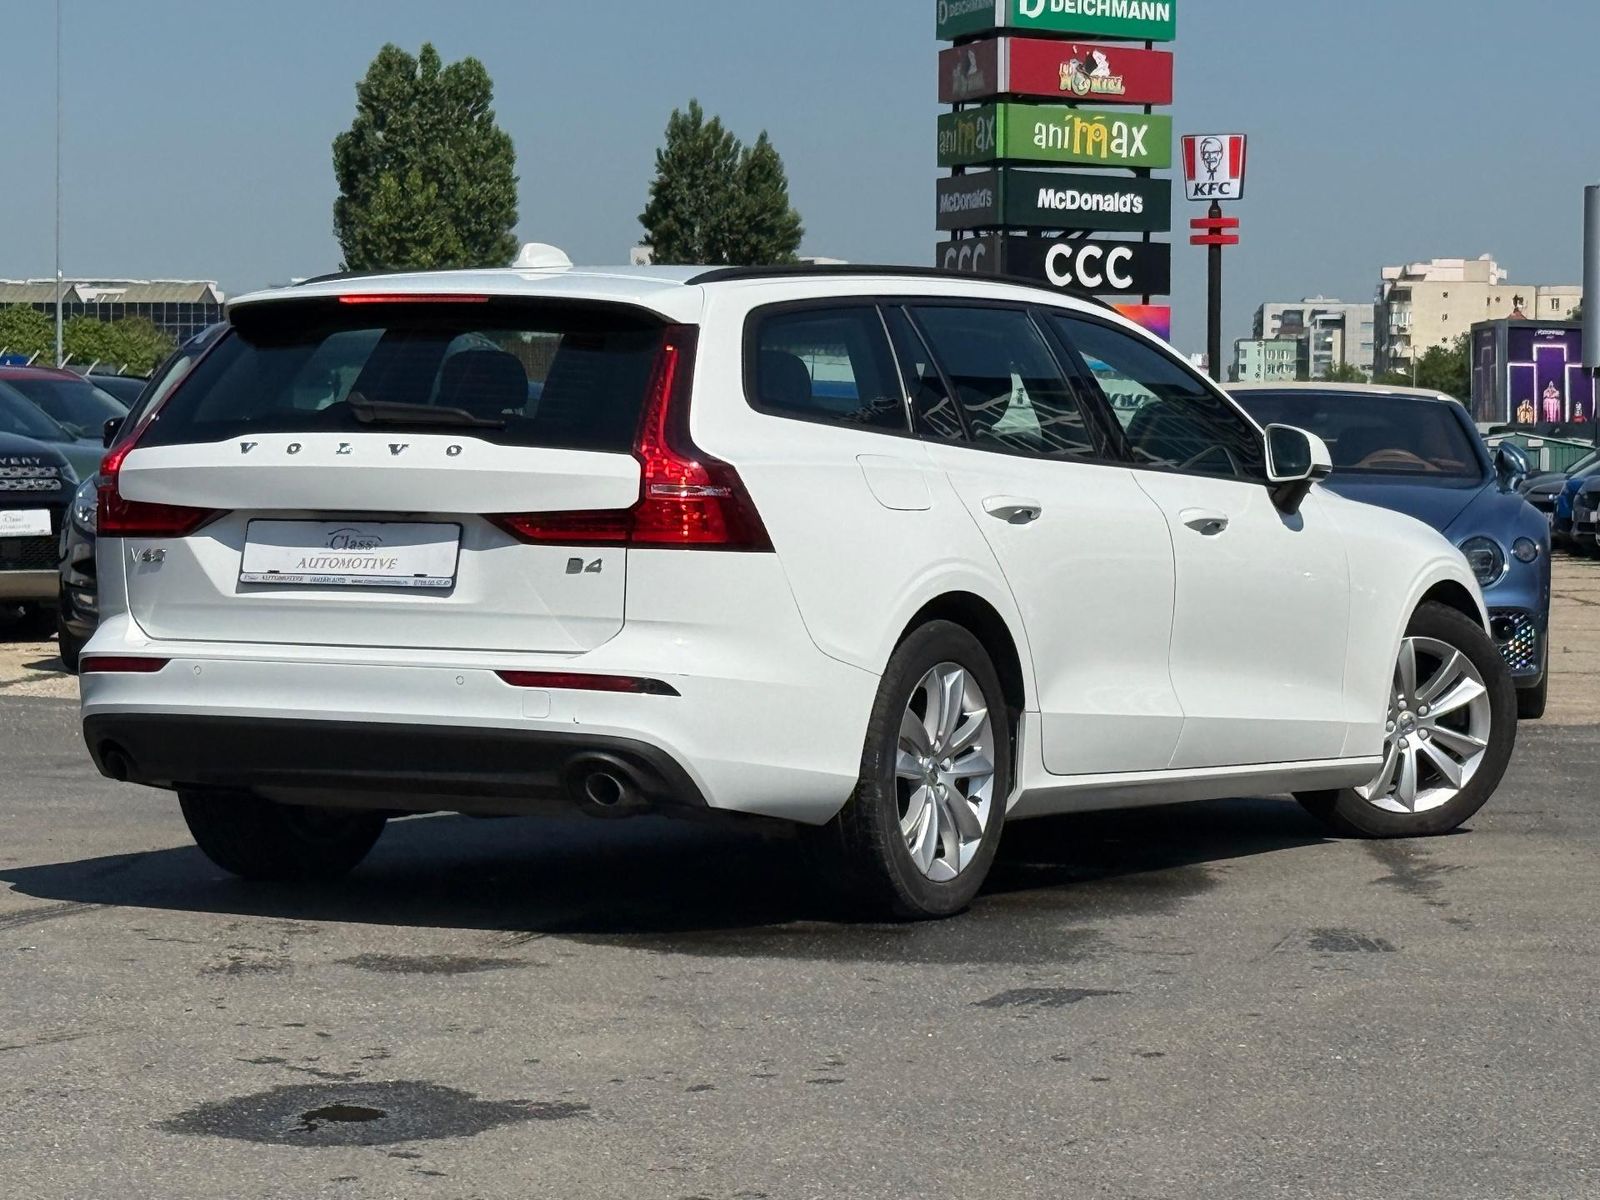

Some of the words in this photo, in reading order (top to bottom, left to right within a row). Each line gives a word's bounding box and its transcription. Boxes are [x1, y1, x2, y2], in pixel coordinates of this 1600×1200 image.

[1050, 0, 1170, 22] DEICHMANN
[1033, 113, 1149, 159] animax
[939, 188, 993, 213] McDonald's
[1037, 187, 1143, 214] McDonald's
[1192, 182, 1231, 197] KFC
[1044, 243, 1134, 289] CCC
[240, 442, 463, 457] VOLVO
[330, 534, 374, 551] Class
[296, 556, 398, 570] AUTOMOTIVE
